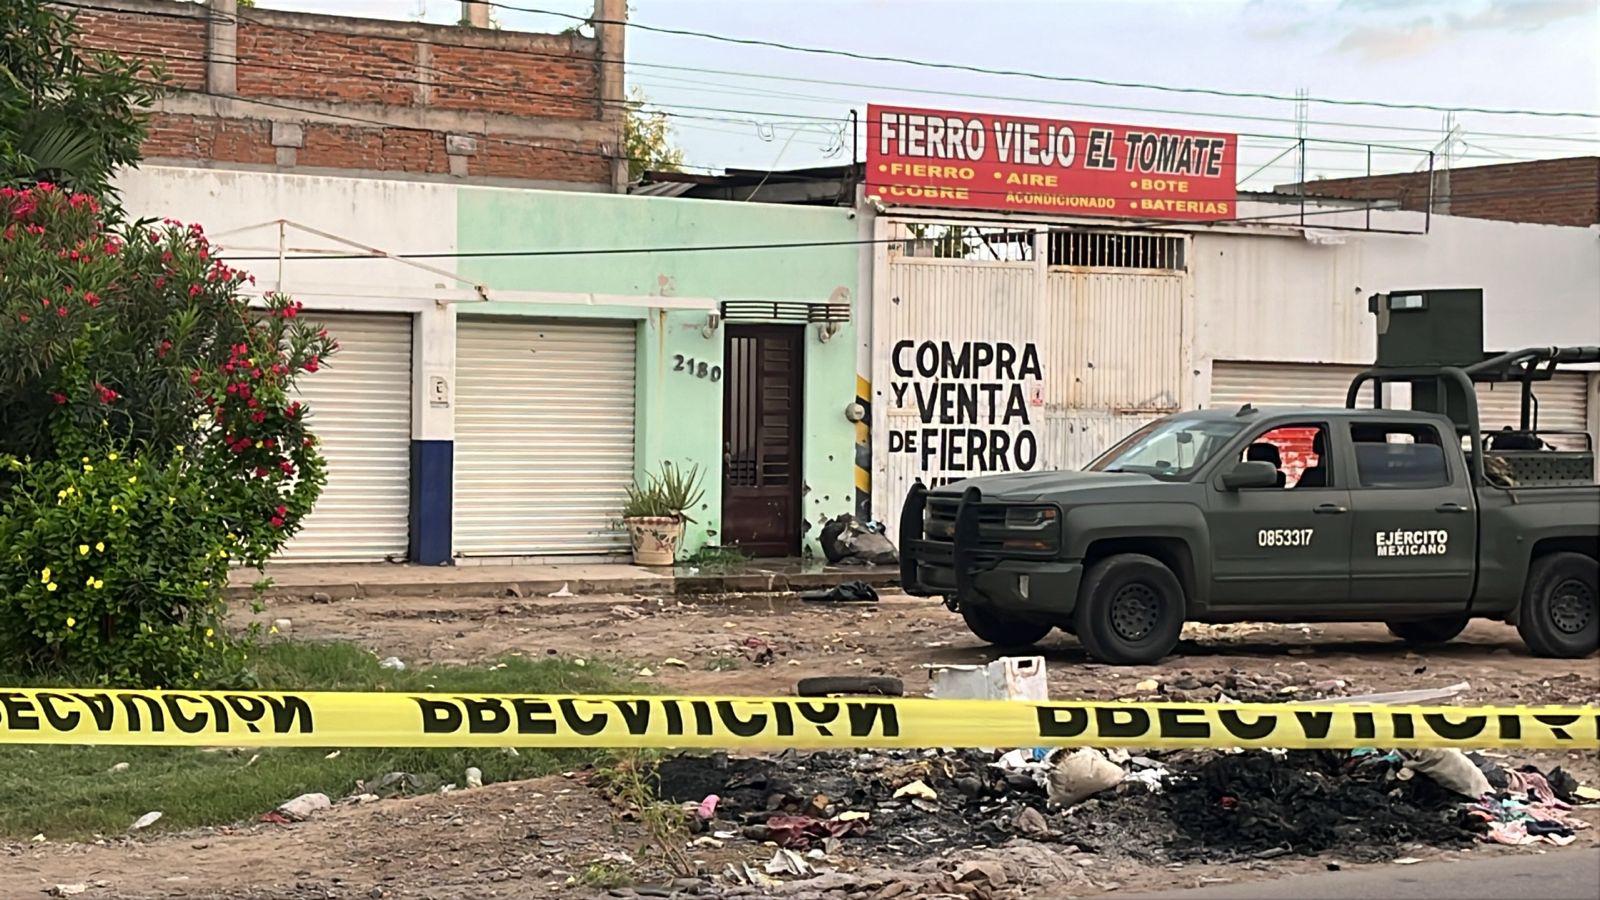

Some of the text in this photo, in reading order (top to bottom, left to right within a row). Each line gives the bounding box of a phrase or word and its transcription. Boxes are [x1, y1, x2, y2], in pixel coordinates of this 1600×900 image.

[880, 112, 1226, 179] FIERRO VIEJO EL TOMATE
[891, 163, 975, 180] FIERRO
[1006, 172, 1059, 188] AIRE
[890, 183, 970, 200] COBRE
[1141, 178, 1189, 193] BOTE
[1005, 191, 1116, 209] ACONDICIONADO
[1141, 198, 1228, 215] BATERIAS
[673, 354, 721, 382] 2180
[892, 340, 1042, 380] COMPRA
[891, 382, 1030, 425] Y VENTA
[888, 428, 1037, 471] DE FIERRO
[1258, 528, 1314, 547] 0853317
[1375, 528, 1449, 546] EJÉRCITO
[1377, 543, 1447, 556] MEXICANO
